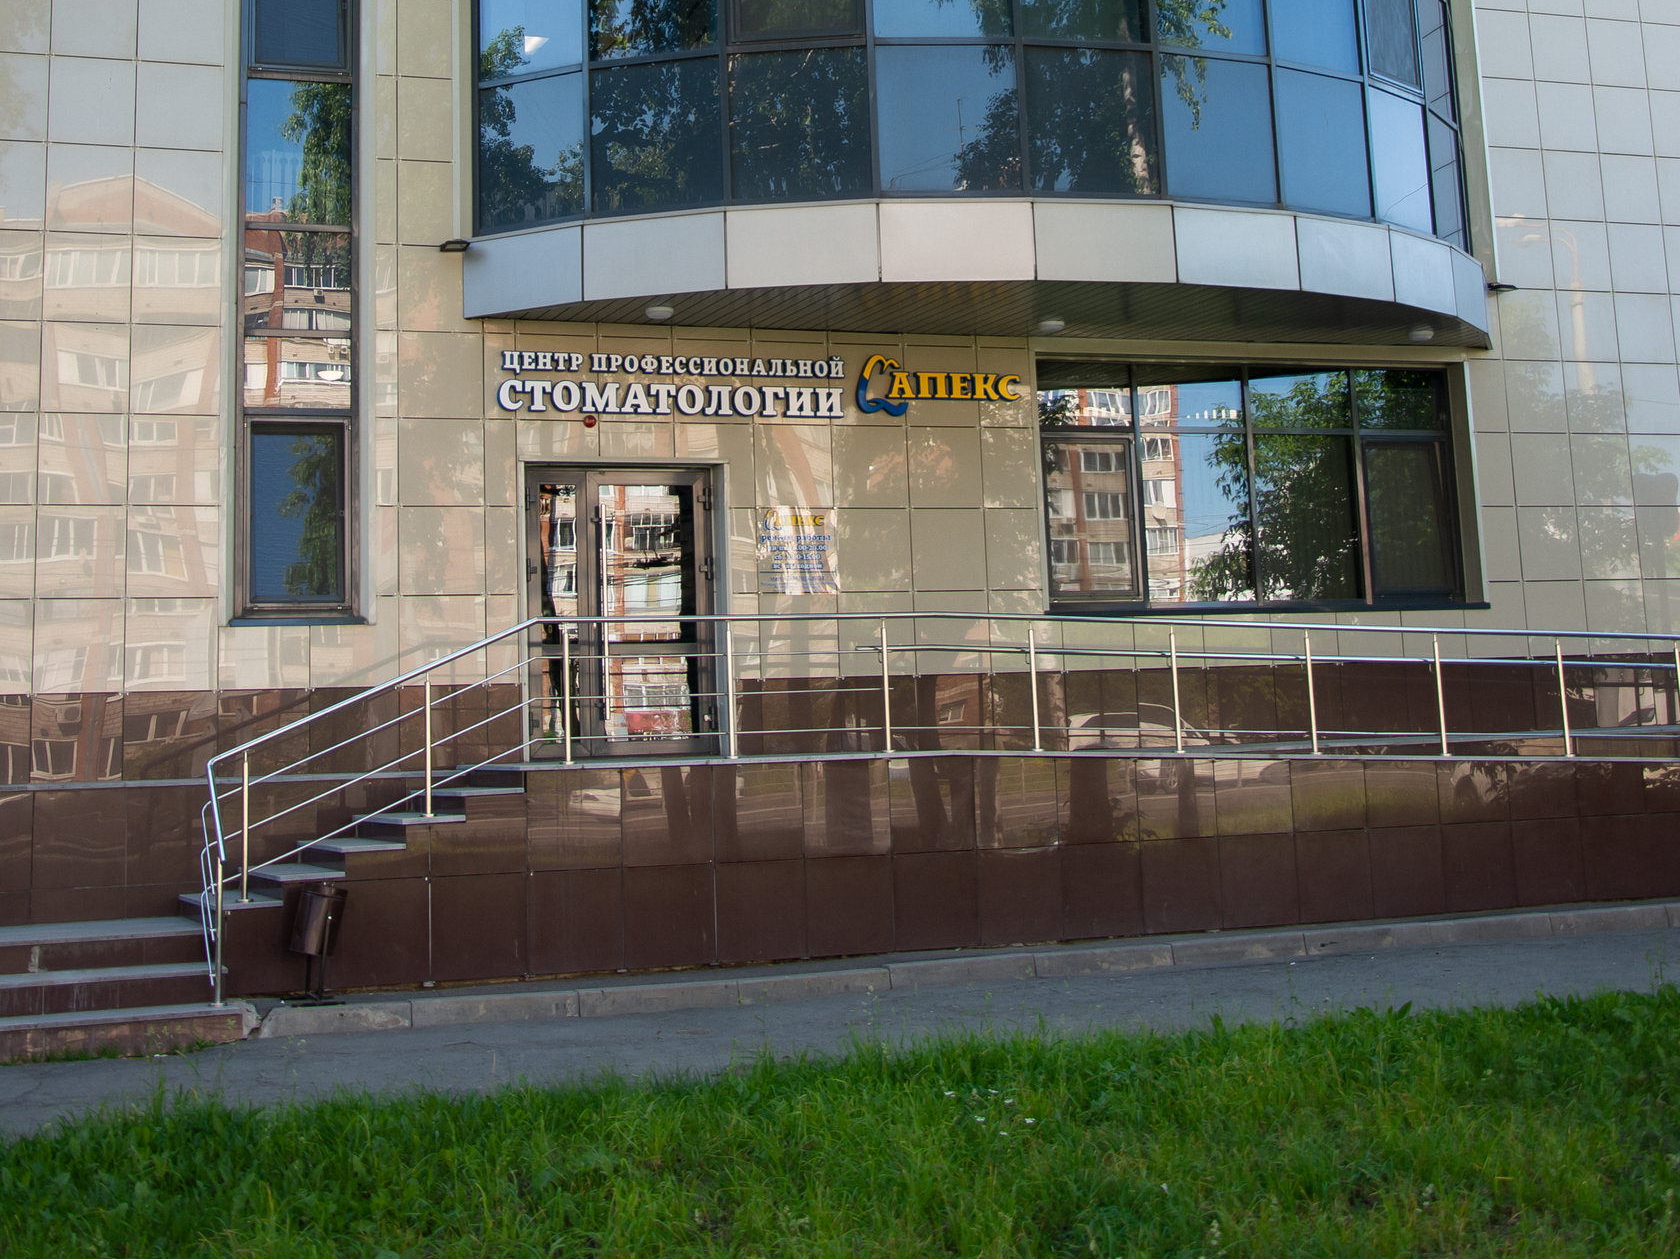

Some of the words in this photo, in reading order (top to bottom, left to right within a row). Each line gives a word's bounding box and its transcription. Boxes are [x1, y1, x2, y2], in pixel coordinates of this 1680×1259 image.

[502, 350, 584, 374] ЦЕНТР
[590, 353, 845, 379] ПРОФЕССИОНАЛЬНОЙ
[497, 379, 845, 419] СТОМАТОЛОГИИ
